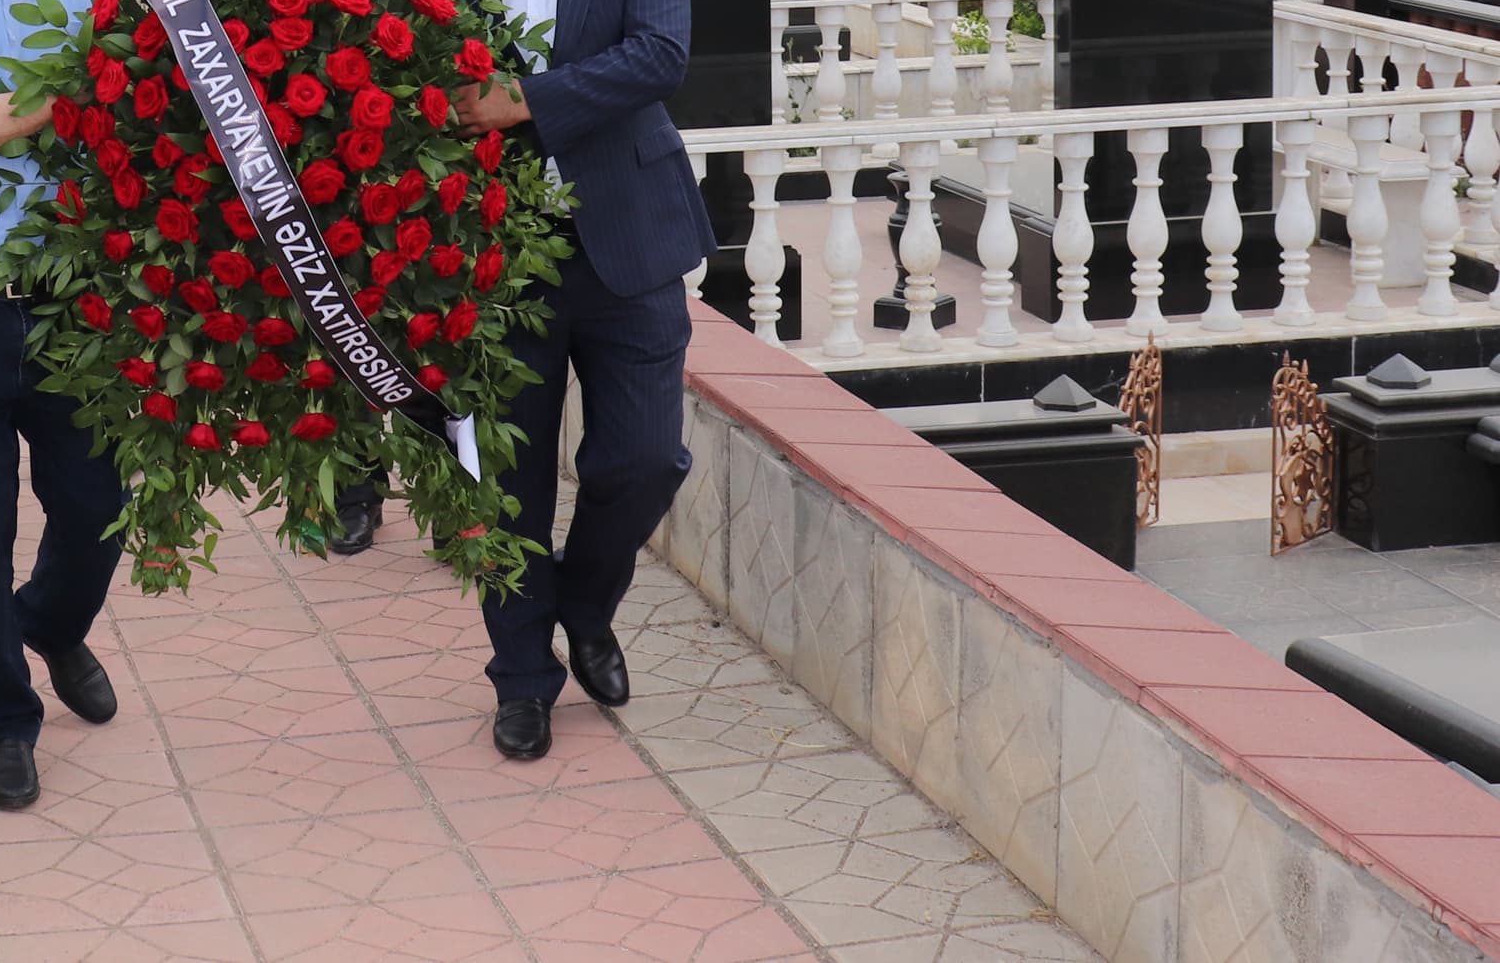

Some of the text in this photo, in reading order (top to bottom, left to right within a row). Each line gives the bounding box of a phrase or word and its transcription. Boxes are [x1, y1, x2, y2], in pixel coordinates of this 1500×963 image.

[178, 21, 296, 222] ZAXARYAYEVİN
[275, 220, 327, 284] ƏZİZ
[304, 280, 413, 404] XATİRƏSİNƏ
